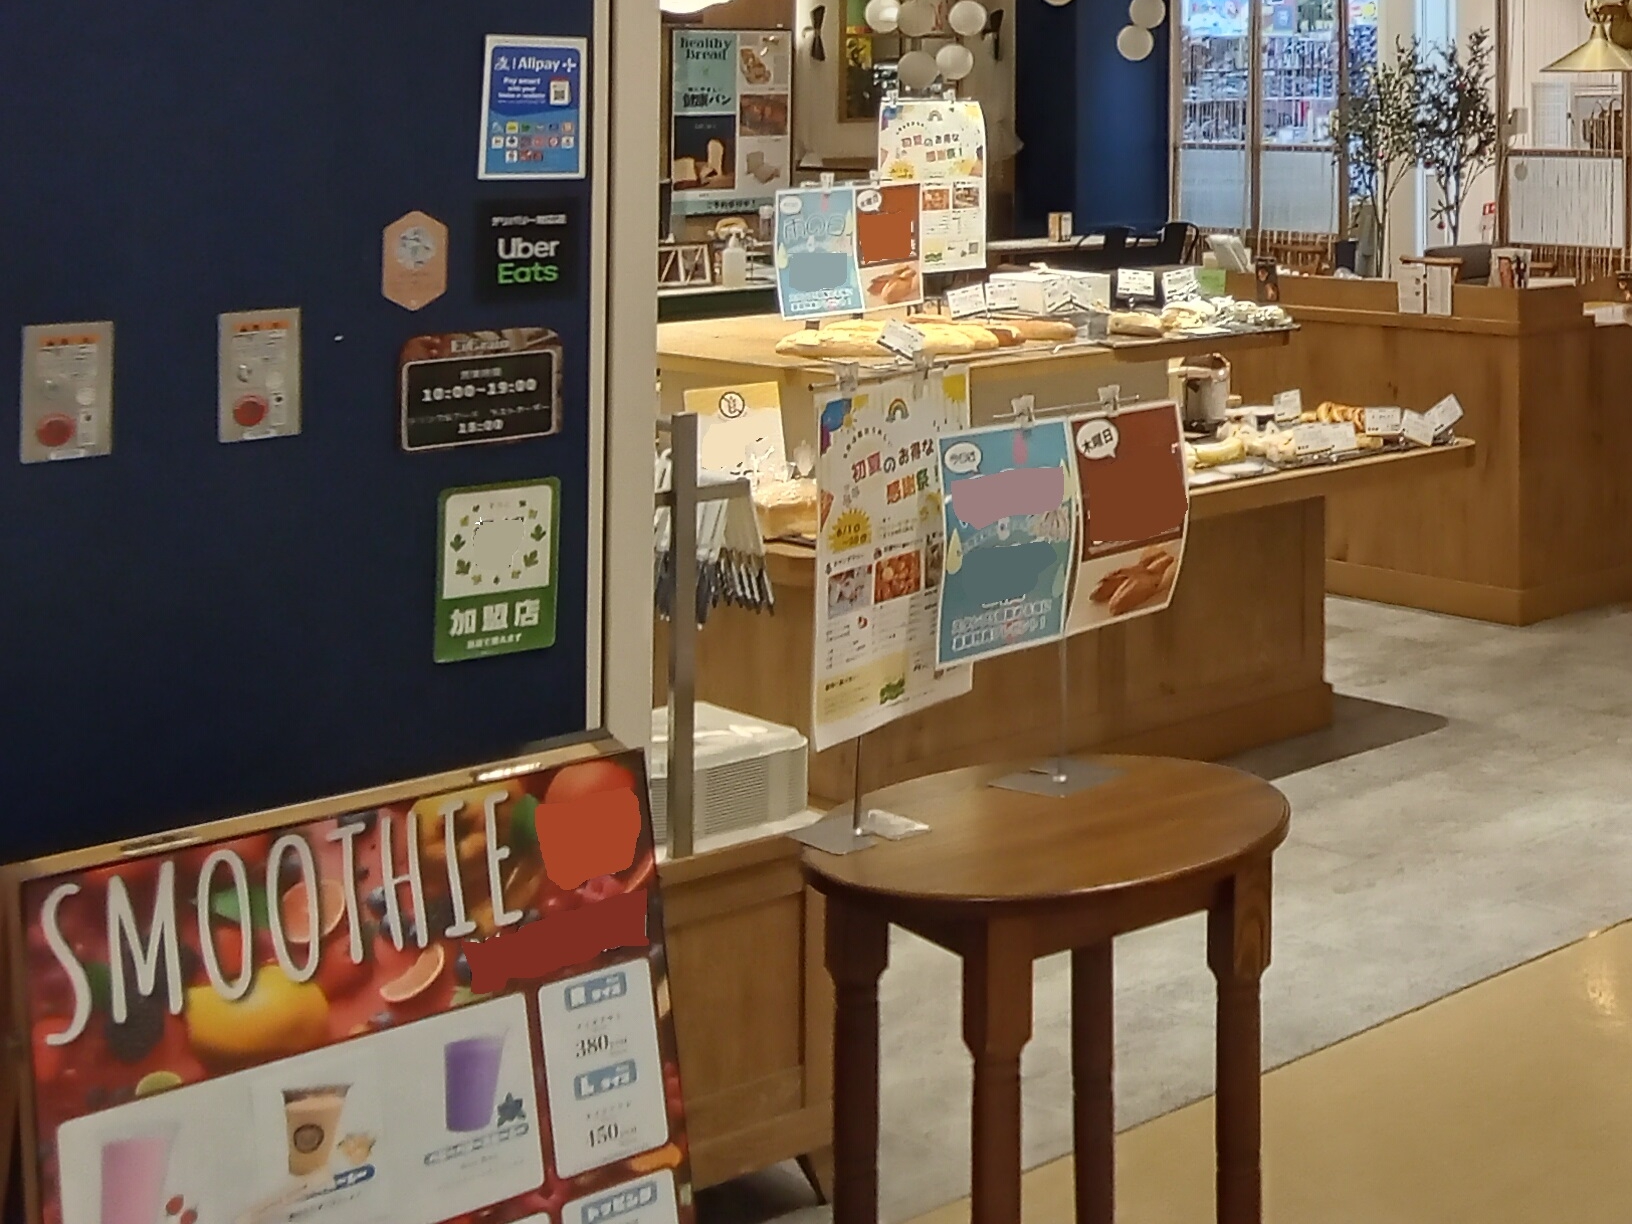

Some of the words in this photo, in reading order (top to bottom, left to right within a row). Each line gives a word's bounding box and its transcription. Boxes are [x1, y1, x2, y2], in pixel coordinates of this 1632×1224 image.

[497, 237, 560, 260] Uber
[496, 262, 560, 285] Eats
[1081, 428, 1114, 454] 木曜日
[449, 598, 541, 637] 加盟店
[42, 791, 524, 1046] SMOOTHIE
[575, 1033, 609, 1059] 380
